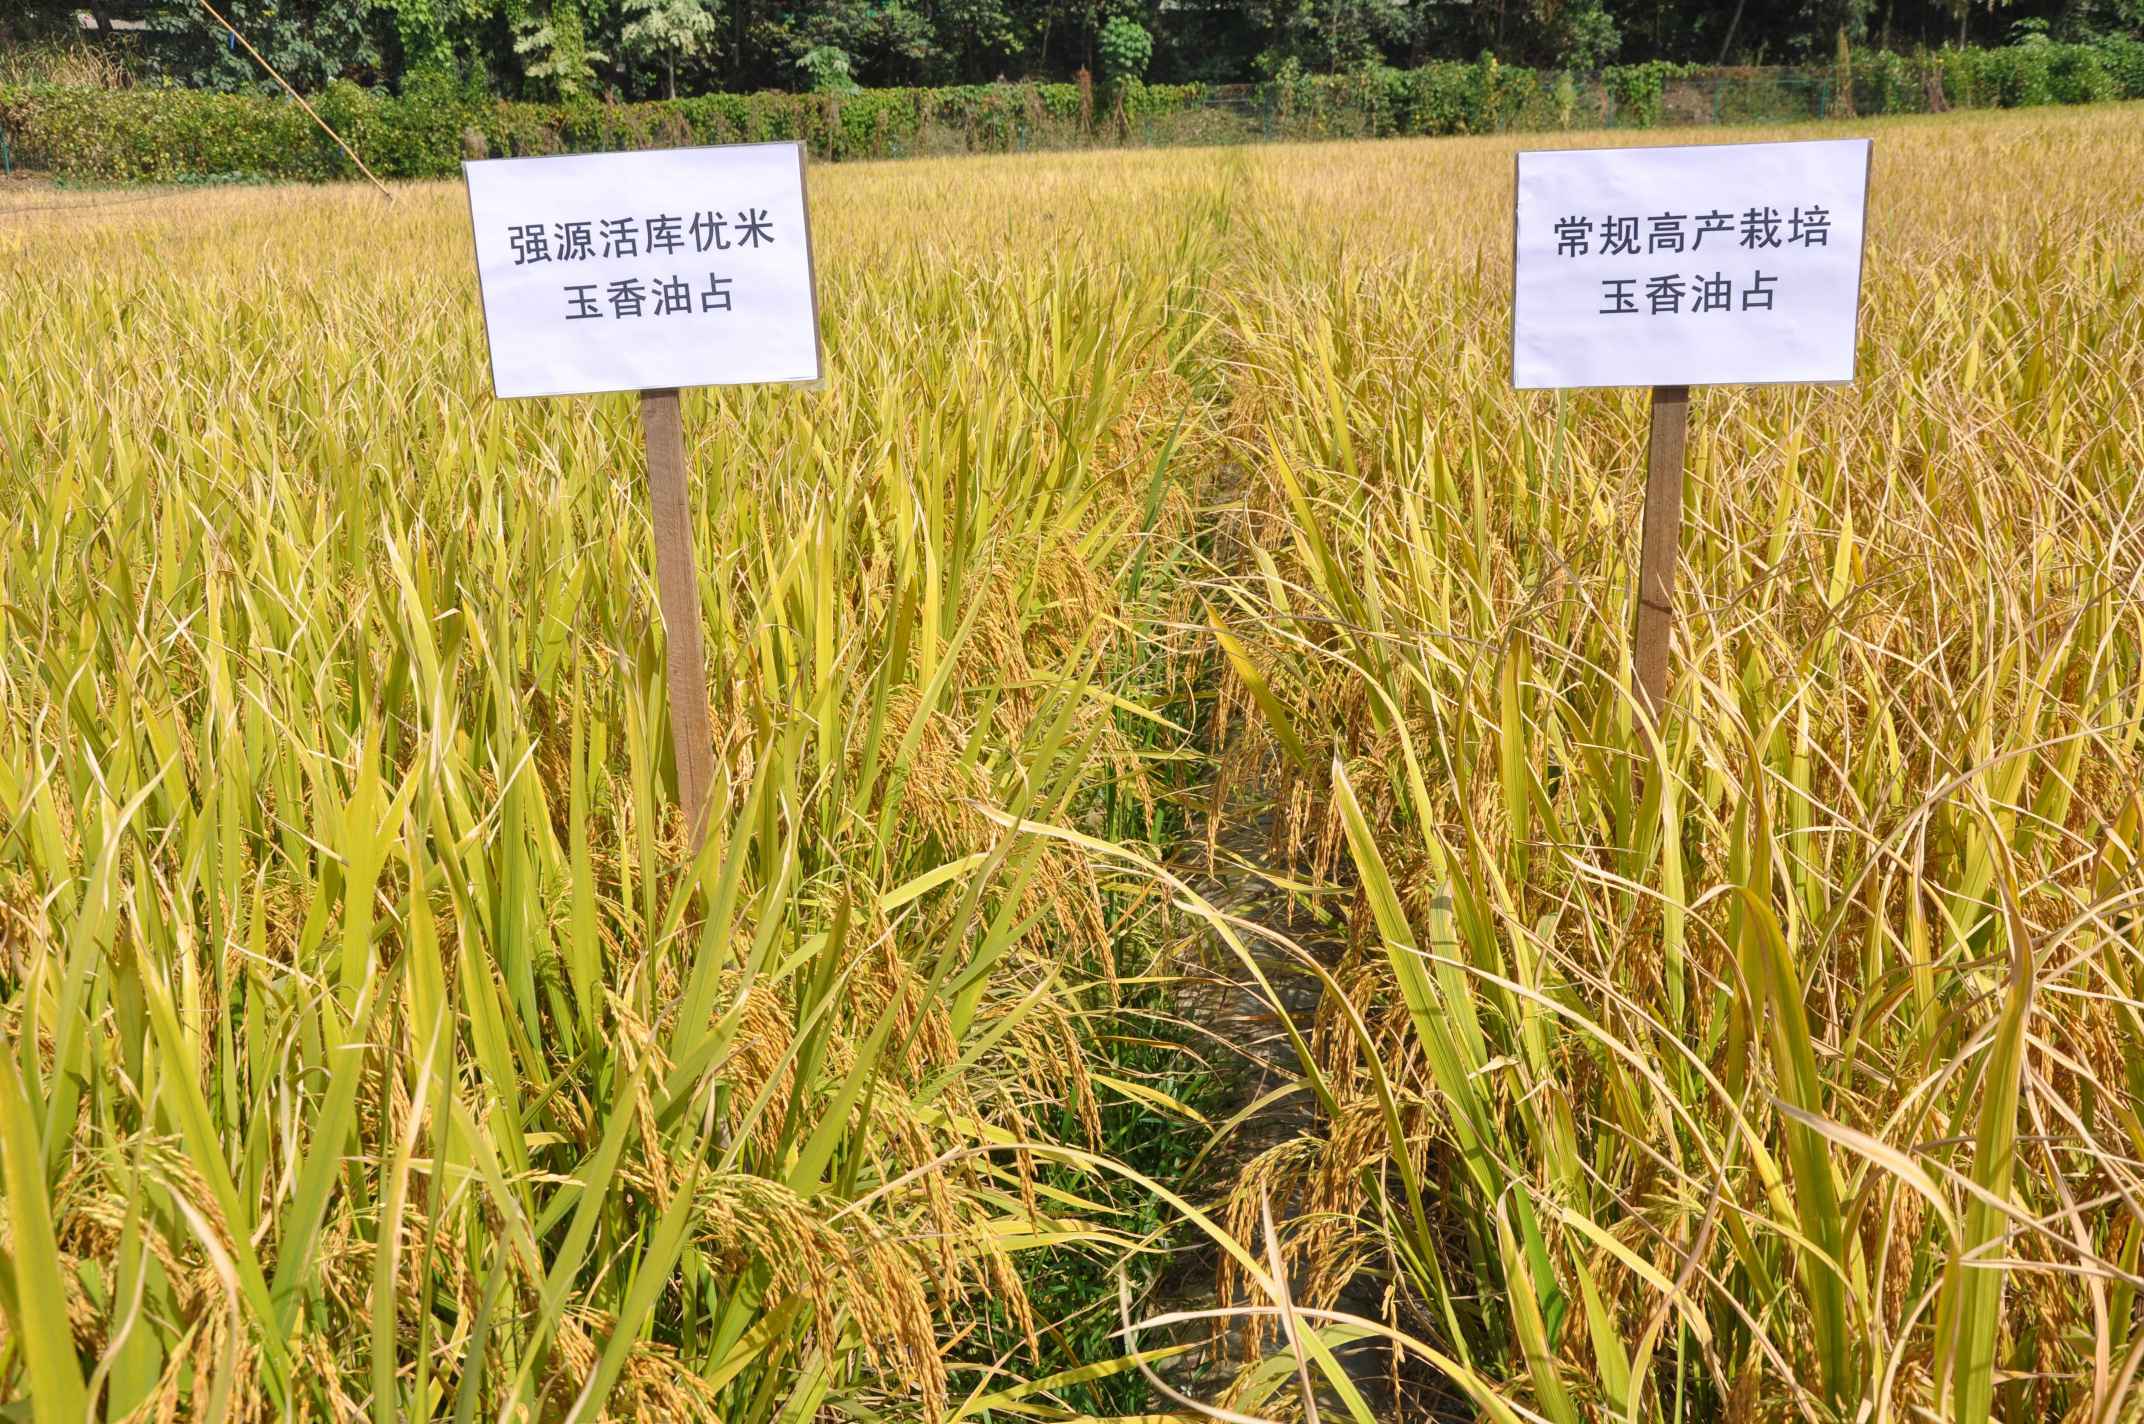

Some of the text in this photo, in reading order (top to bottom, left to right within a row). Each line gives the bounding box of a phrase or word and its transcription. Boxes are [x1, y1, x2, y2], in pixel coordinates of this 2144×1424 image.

[507, 208, 775, 265] 强源活库优米
[1554, 204, 1831, 258] 常规高产栽培
[563, 272, 733, 320] 玉香油占
[1599, 269, 1778, 315] 玉香油占
